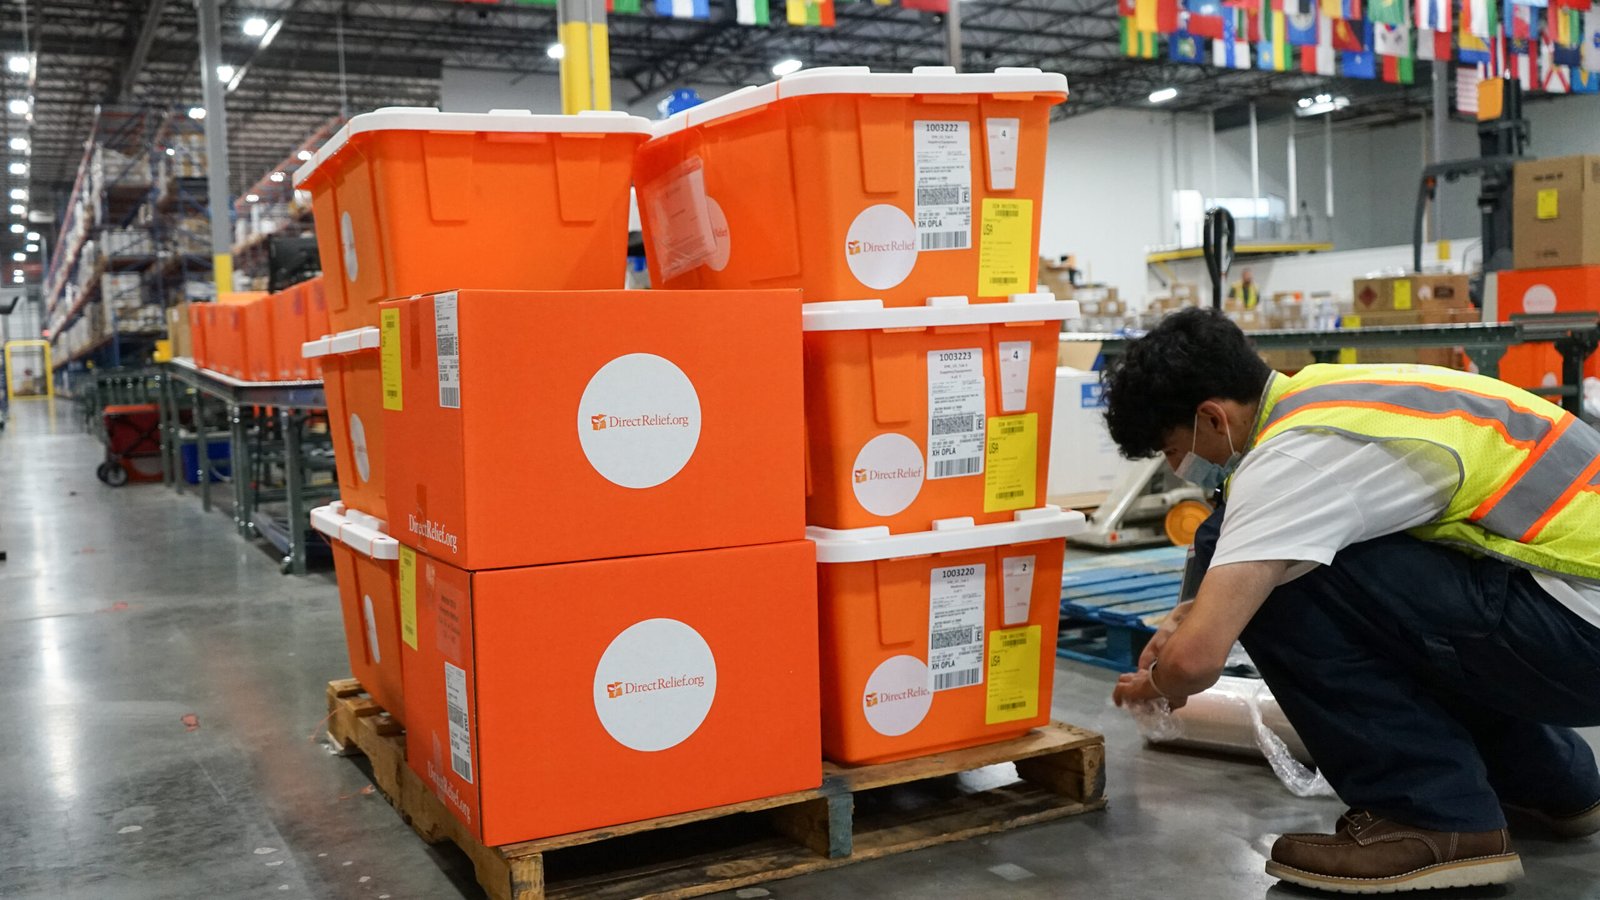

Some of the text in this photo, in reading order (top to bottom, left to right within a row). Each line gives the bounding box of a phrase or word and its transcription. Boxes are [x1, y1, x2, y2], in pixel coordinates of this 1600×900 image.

[926, 123, 959, 132] 1003222
[1001, 129, 1007, 138] 4
[939, 352, 972, 361] 1003223
[1013, 350, 1019, 359] 4
[989, 442, 999, 455] USA
[1022, 563, 1027, 572] 2
[942, 567, 975, 578] 1003220
